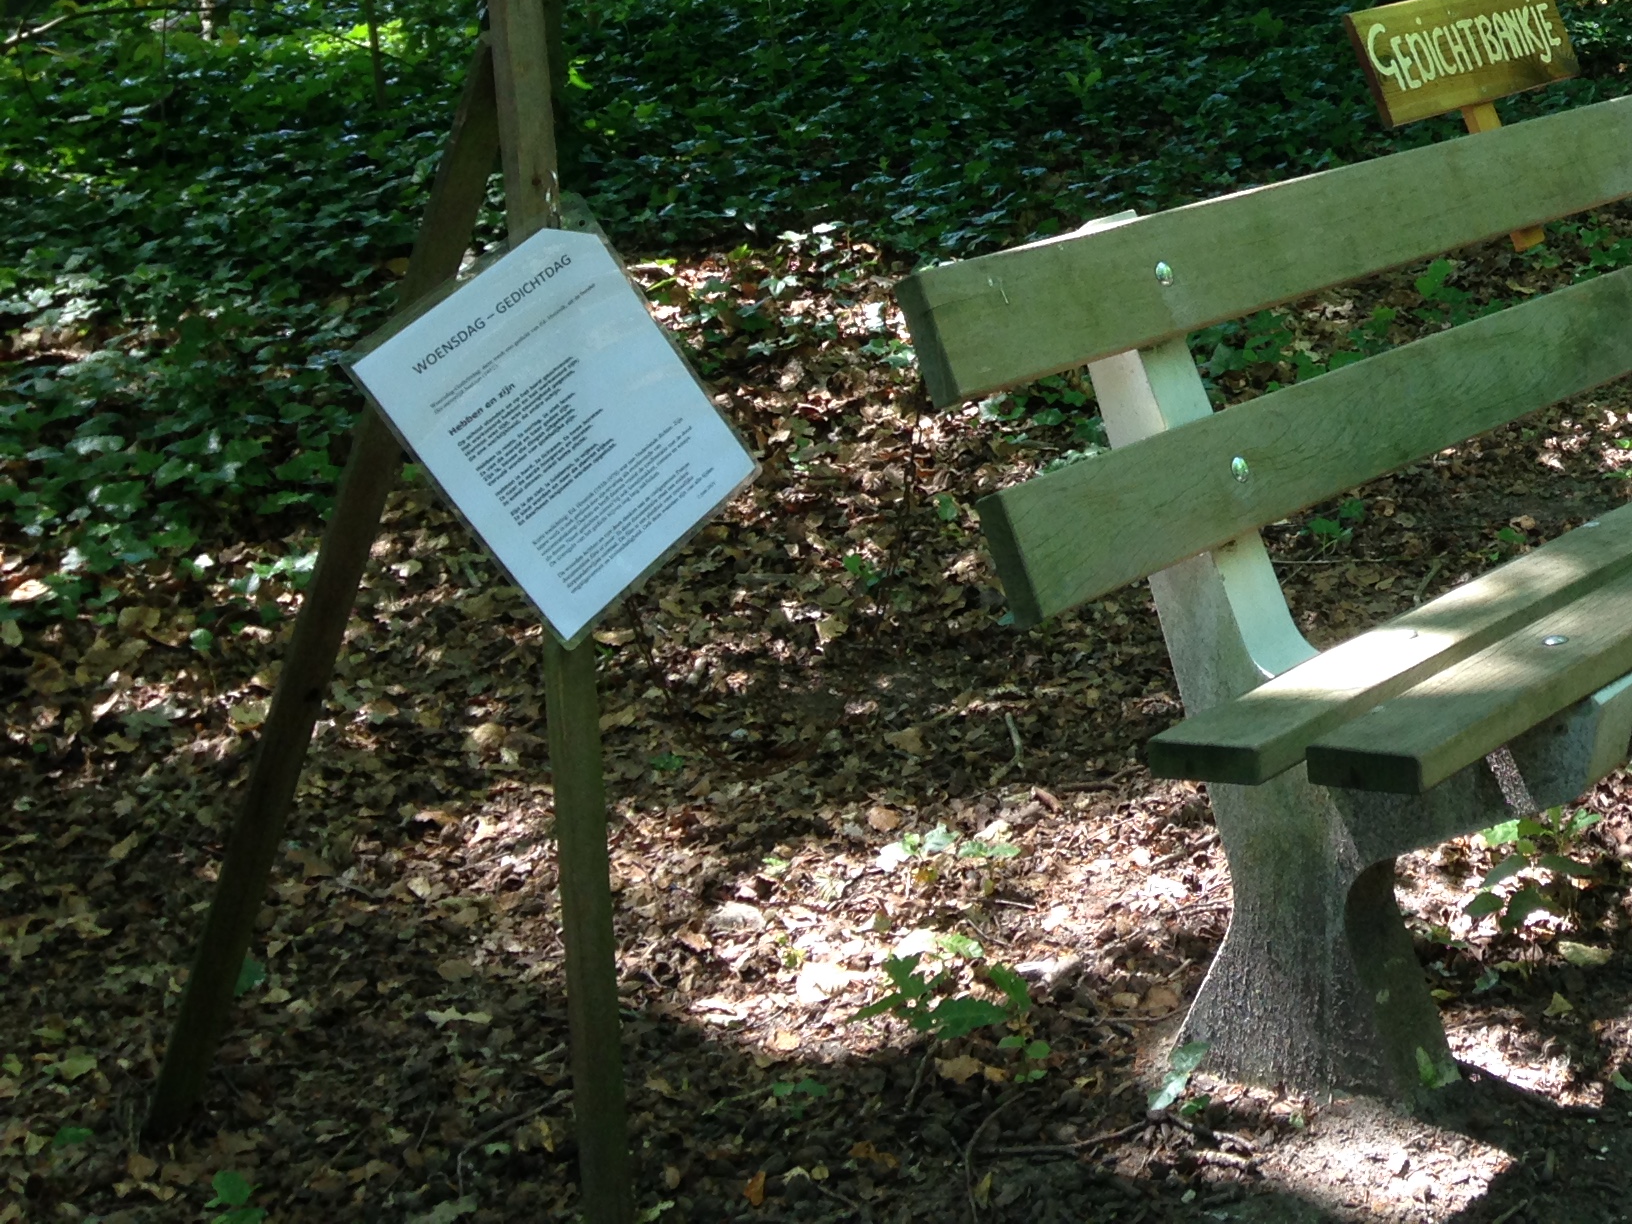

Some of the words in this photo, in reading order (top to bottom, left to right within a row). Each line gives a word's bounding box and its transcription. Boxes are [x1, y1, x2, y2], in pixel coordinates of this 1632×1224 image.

[412, 317, 486, 375] WOENSDAG
[495, 254, 572, 314] GEDICHTDAG
[448, 407, 484, 436] Hebben
[485, 397, 497, 409] en
[499, 382, 516, 399] zijn
